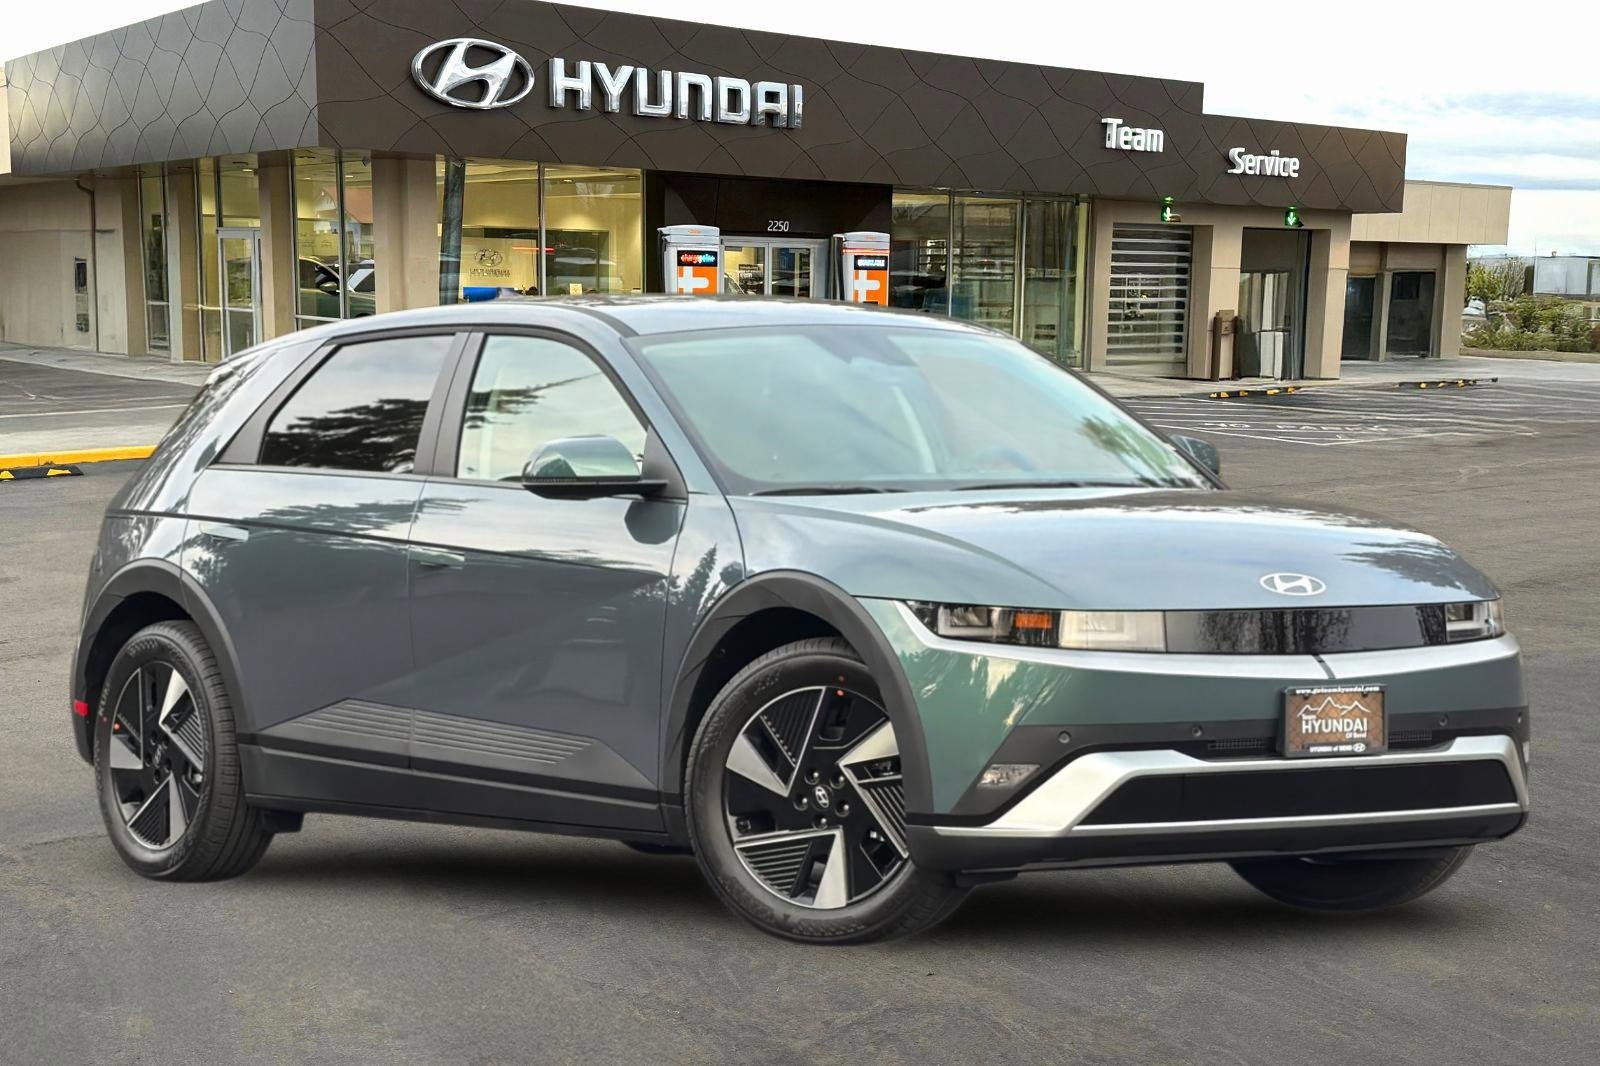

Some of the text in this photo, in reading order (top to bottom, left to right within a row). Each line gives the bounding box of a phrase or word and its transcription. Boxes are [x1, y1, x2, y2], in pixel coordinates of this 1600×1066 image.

[548, 57, 803, 129] HYUNDAI
[1101, 117, 1164, 152] Team
[1227, 147, 1300, 178] Service
[767, 220, 790, 232] 2250
[1302, 718, 1368, 734] HYUNDAI
